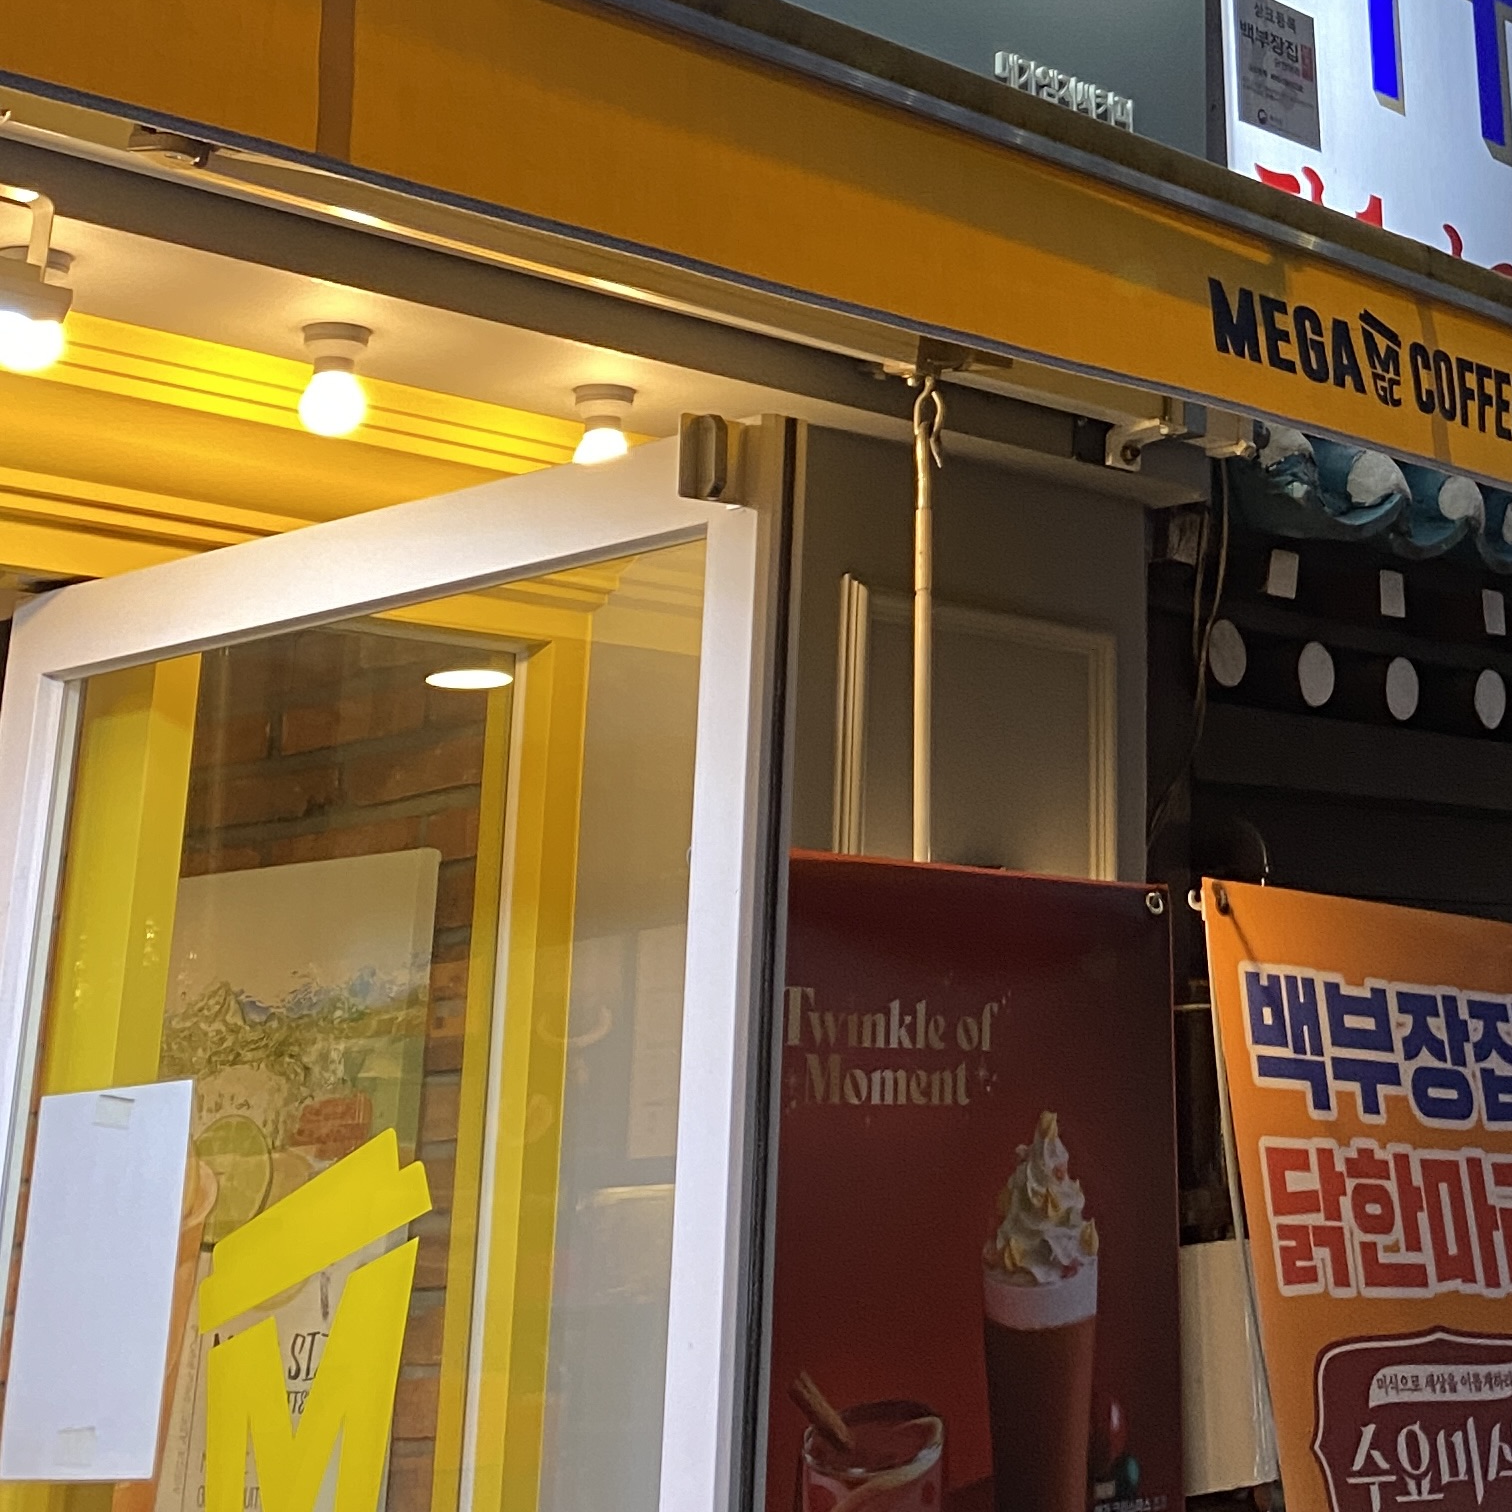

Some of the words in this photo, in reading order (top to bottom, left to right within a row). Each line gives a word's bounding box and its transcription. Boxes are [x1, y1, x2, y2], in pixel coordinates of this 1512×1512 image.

[1239, 19, 1299, 63] 백부장집
[1208, 277, 1367, 395] MEGA
[784, 986, 946, 1051] Twinkle
[956, 1001, 999, 1052] of
[806, 1053, 972, 1106] Moment
[1376, 1372, 1422, 1395] 미식으로
